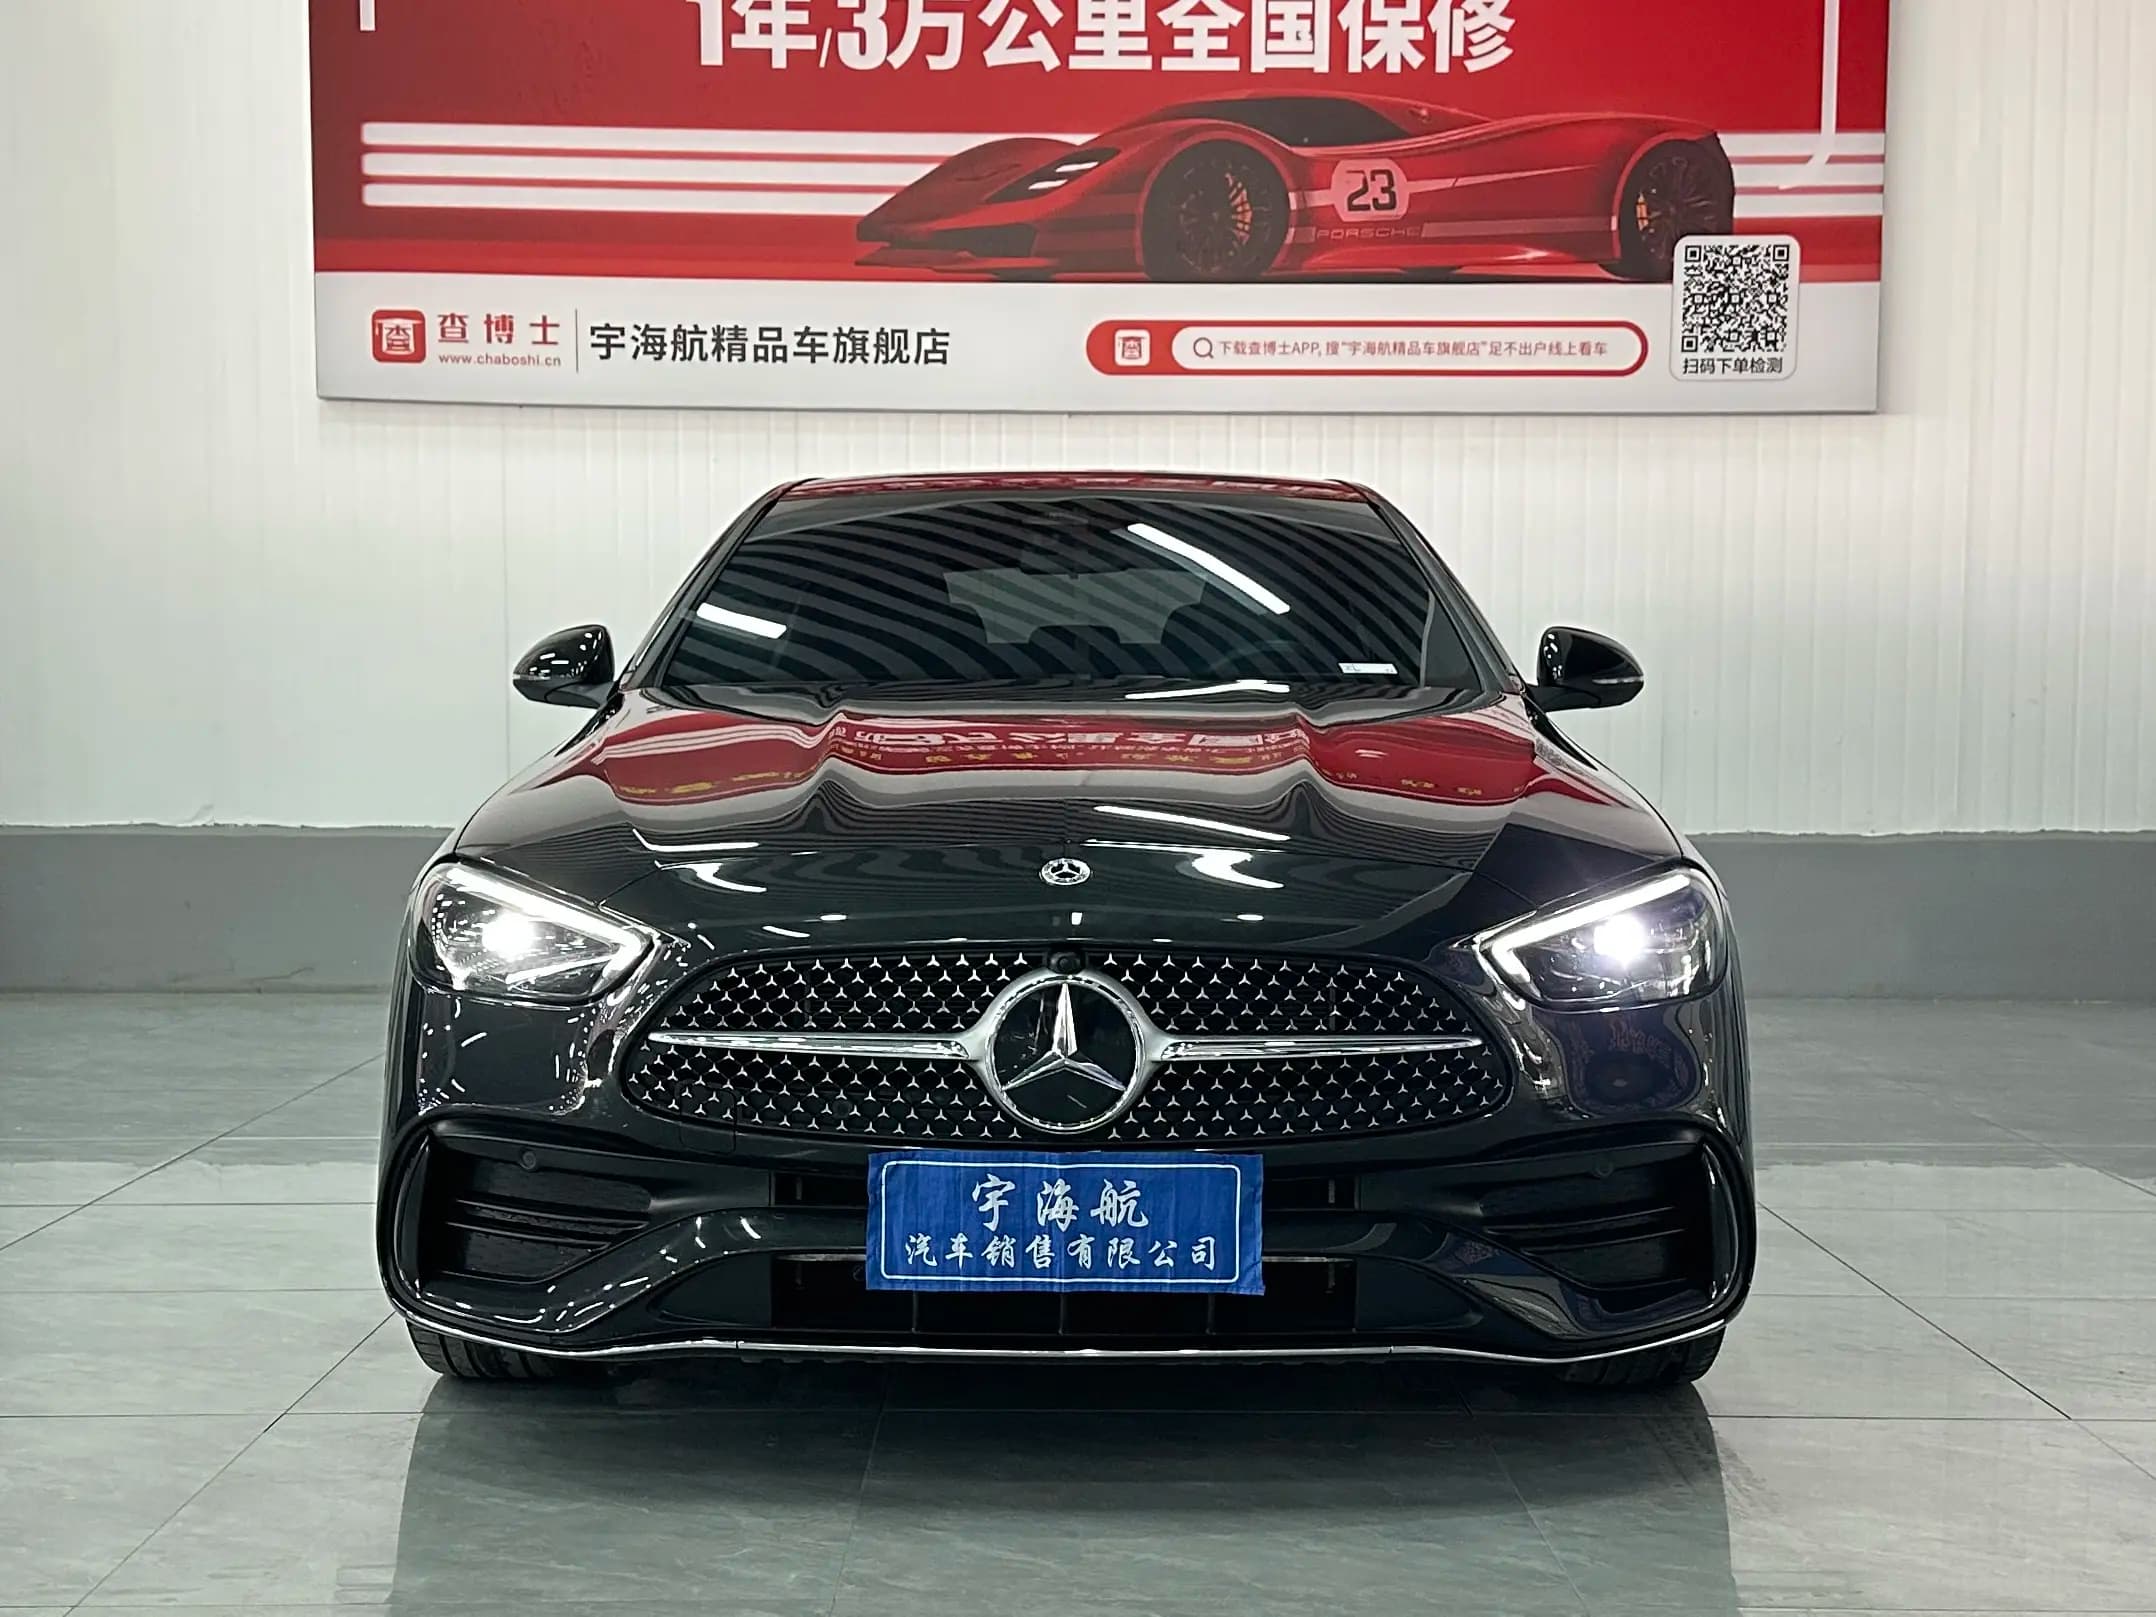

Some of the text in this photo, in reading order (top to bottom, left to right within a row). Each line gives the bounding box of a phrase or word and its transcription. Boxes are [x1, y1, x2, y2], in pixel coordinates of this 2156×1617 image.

[1346, 169, 1397, 212] 23
[437, 312, 560, 345] 查博士
[590, 322, 951, 366] 宇海航精品车旗舰店
[438, 353, 562, 367] www.chaboshi.cn
[1683, 357, 1783, 374] 扫码下单检测
[971, 1173, 1149, 1232] 宇海航
[904, 1233, 1218, 1271] 汽车销售有限公司
